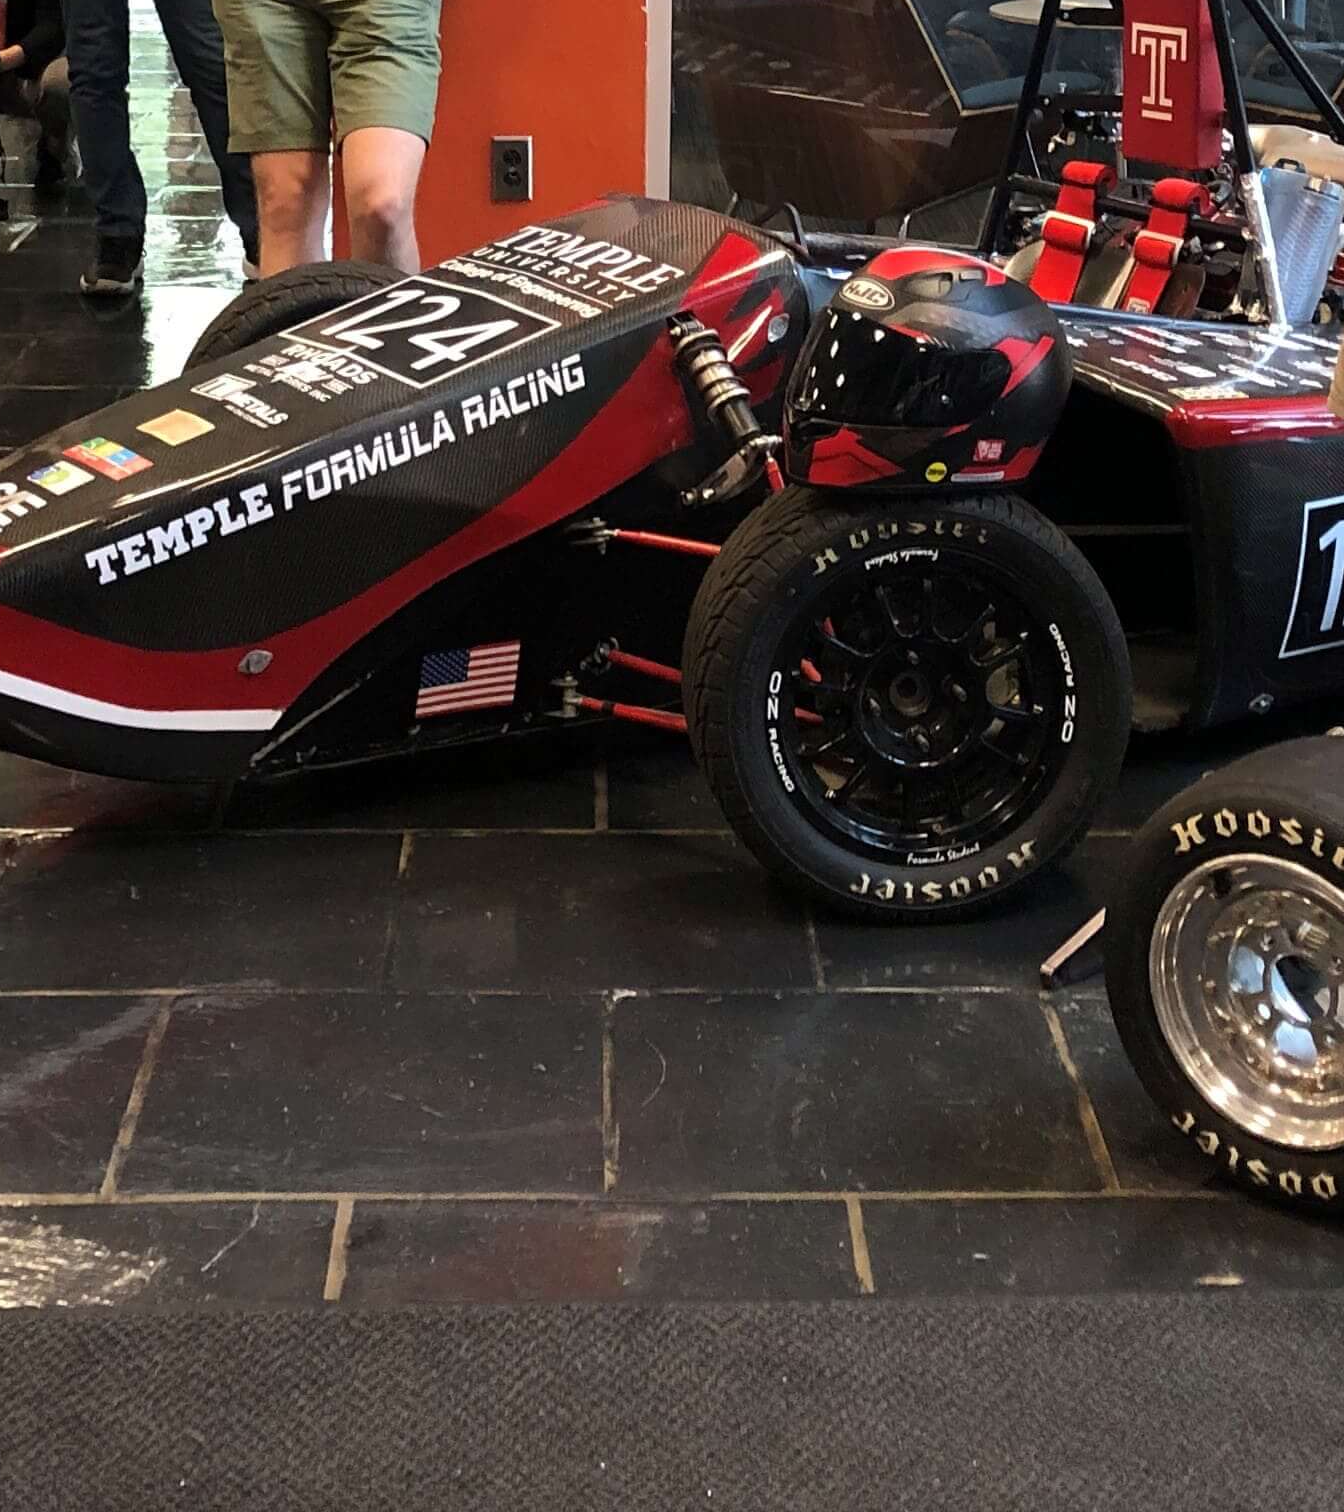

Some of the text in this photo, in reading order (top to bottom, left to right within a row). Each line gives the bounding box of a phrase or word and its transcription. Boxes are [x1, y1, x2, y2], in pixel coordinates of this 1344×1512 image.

[1131, 22, 1188, 122] T
[439, 258, 494, 279] College
[506, 273, 603, 318] Engineering
[464, 225, 686, 293] TEMPLE
[472, 247, 636, 302] UNIVERSITY
[320, 289, 519, 371] 124
[281, 343, 378, 385] RHOADS
[224, 391, 289, 425] METALS
[86, 354, 586, 585] TEMPLE FORMULA RACING
[1048, 622, 1075, 688] RACING
[768, 727, 795, 793] RACING
[906, 841, 981, 866] Formula Student
